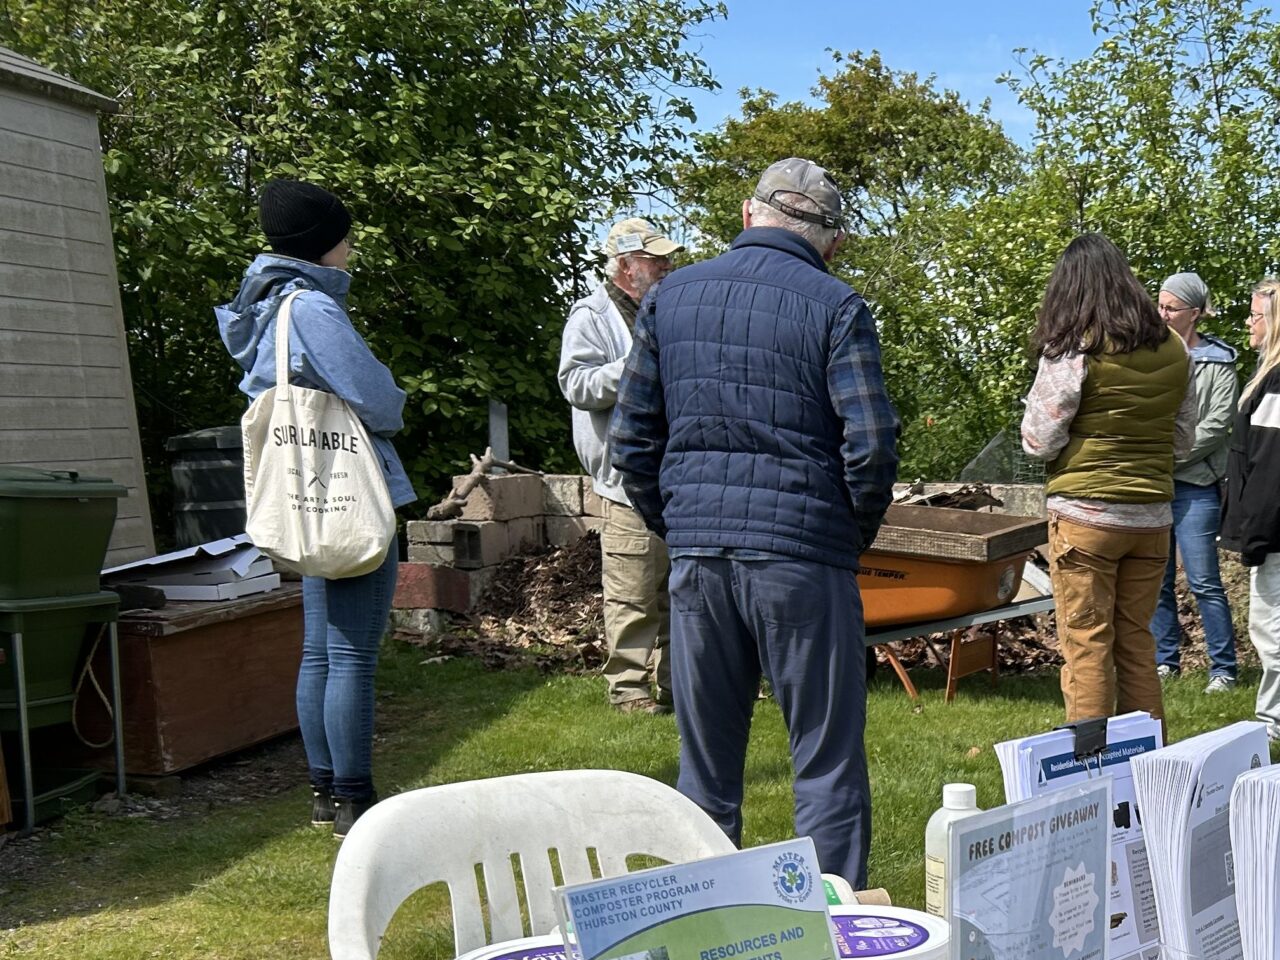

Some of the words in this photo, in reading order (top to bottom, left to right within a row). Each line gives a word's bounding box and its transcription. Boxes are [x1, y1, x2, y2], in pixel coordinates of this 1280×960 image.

[273, 425, 298, 447] SUR
[300, 427, 316, 448] LA
[319, 431, 359, 455] ABLE
[306, 505, 348, 514] COOKING
[333, 495, 357, 503] SOUL
[1050, 758, 1074, 772] Residential
[1101, 748, 1122, 761] ccepted
[1122, 745, 1145, 756] Materials
[969, 838, 995, 861] FREE
[998, 821, 1046, 851] COMPOST
[1049, 803, 1100, 834] GIVEAWAY
[772, 851, 805, 871] MASTER
[571, 887, 617, 906] MASTER
[620, 875, 678, 895] RECYCLER
[574, 896, 644, 919] COMPOSTER
[647, 882, 700, 904] PROGRAM
[702, 879, 716, 890] OF
[577, 909, 638, 932] THURSTON
[640, 900, 684, 917] COUNTY
[780, 926, 805, 943] AND
